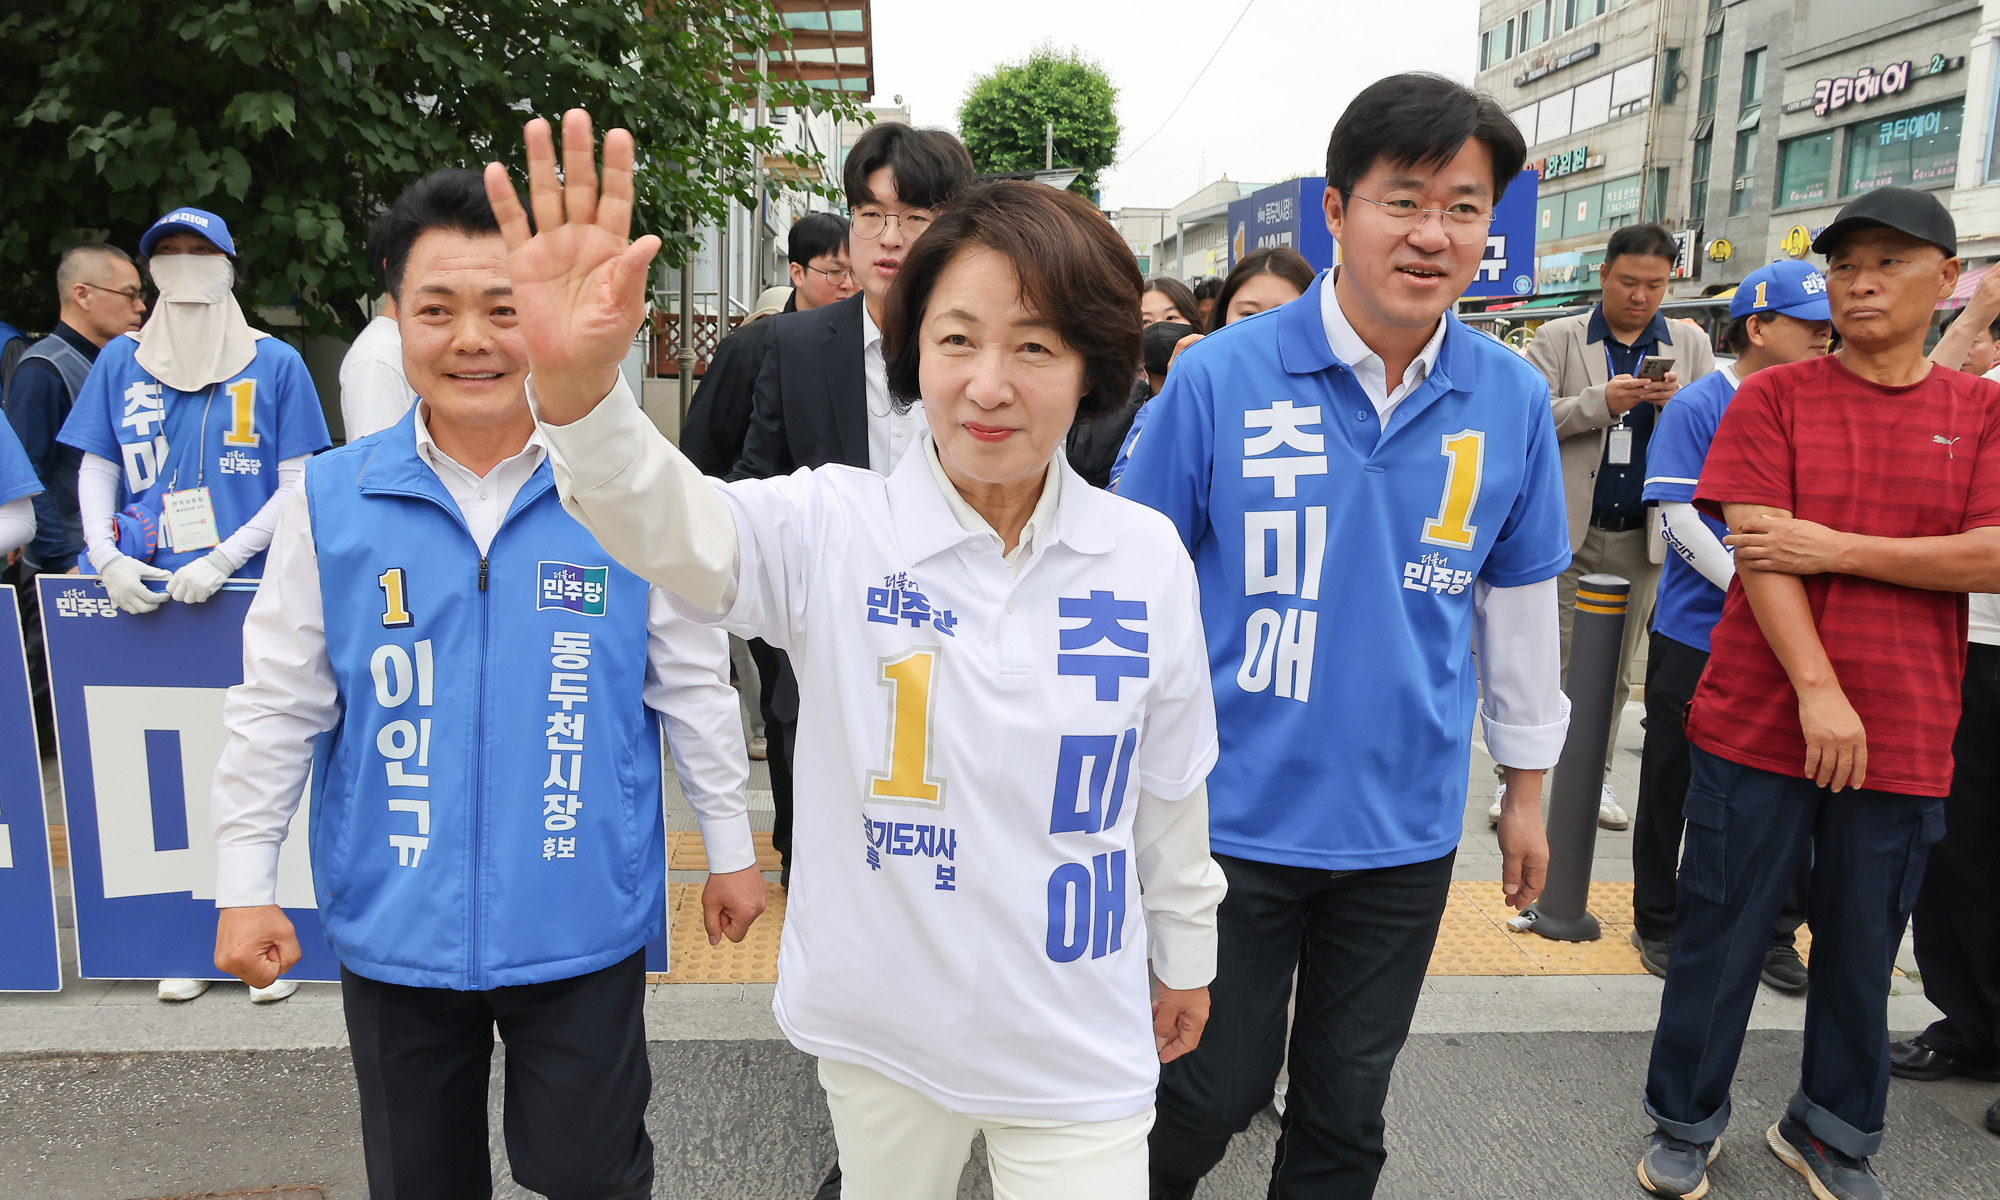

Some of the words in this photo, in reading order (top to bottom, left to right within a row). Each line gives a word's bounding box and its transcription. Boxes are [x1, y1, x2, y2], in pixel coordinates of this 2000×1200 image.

[1930, 54, 1945, 74] 2F
[1814, 61, 1911, 117] 큐티헤어
[1880, 111, 1940, 146] 큐티헤어
[1265, 199, 1291, 225] 동두천시장
[1753, 281, 1768, 308] 1
[223, 378, 260, 448] 1
[121, 381, 174, 549] 추미
[219, 457, 262, 475] 민주당
[1420, 428, 1486, 551] 1
[1236, 400, 1328, 703] 추미애
[1420, 552, 1449, 569] 더불어
[543, 579, 603, 603] 민주당
[553, 569, 576, 582] 더불어
[884, 571, 919, 592] 더불어
[1403, 561, 1473, 595] 민주당
[56, 598, 119, 618] 민주당
[62, 588, 86, 599] 더불어
[378, 567, 412, 628] 1
[867, 587, 957, 637] 민주당
[543, 631, 592, 831] 동두천시장
[865, 646, 946, 810] 1
[370, 639, 434, 869] 이인규
[1046, 590, 1149, 963] 추미애
[542, 836, 576, 861] 후보
[862, 812, 956, 860] 경기도지사
